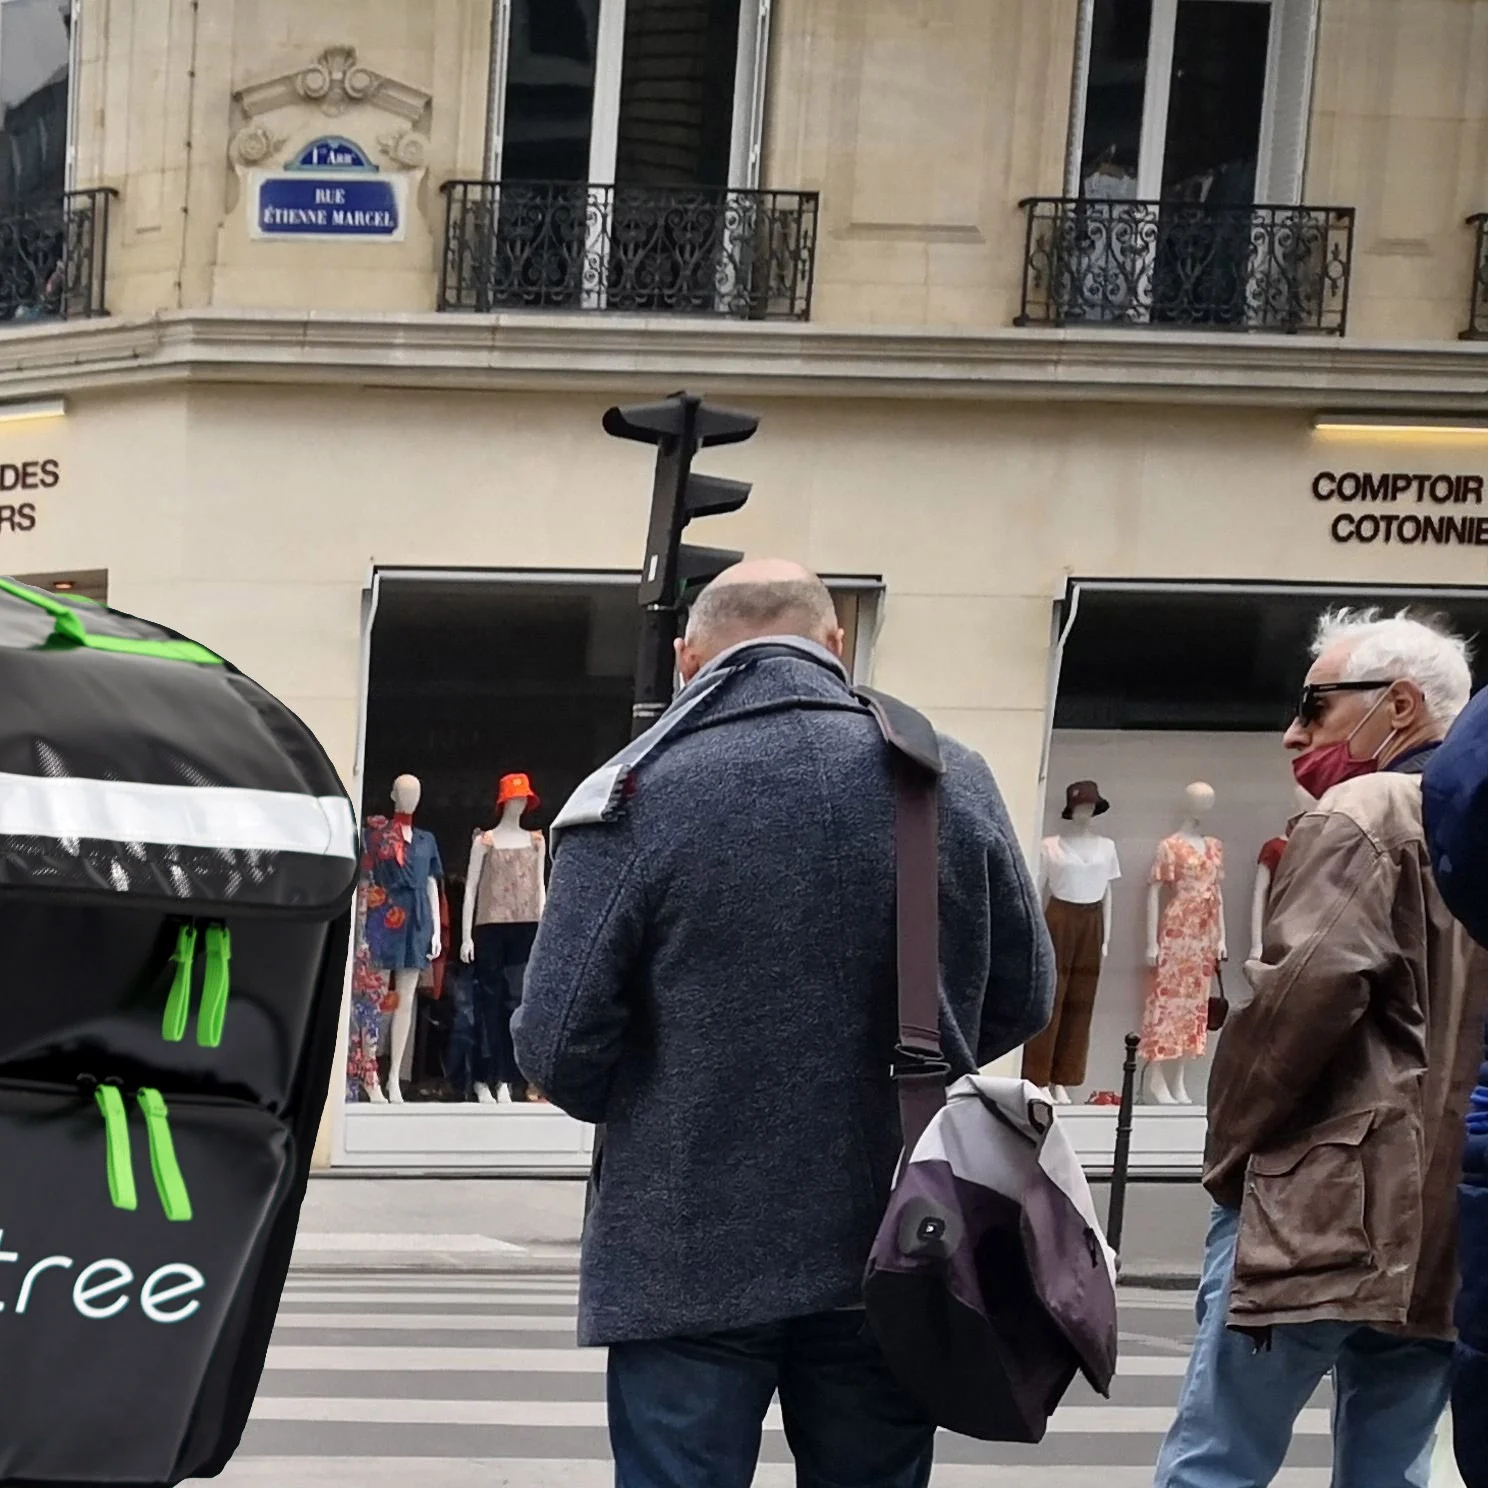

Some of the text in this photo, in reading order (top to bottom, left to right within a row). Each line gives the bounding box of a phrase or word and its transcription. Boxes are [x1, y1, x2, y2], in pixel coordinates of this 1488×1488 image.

[315, 188, 346, 205] RUE
[263, 204, 395, 227] ÉTIENNE MARCEL
[0, 459, 60, 492] DES
[1312, 471, 1484, 504] COMPTOIR
